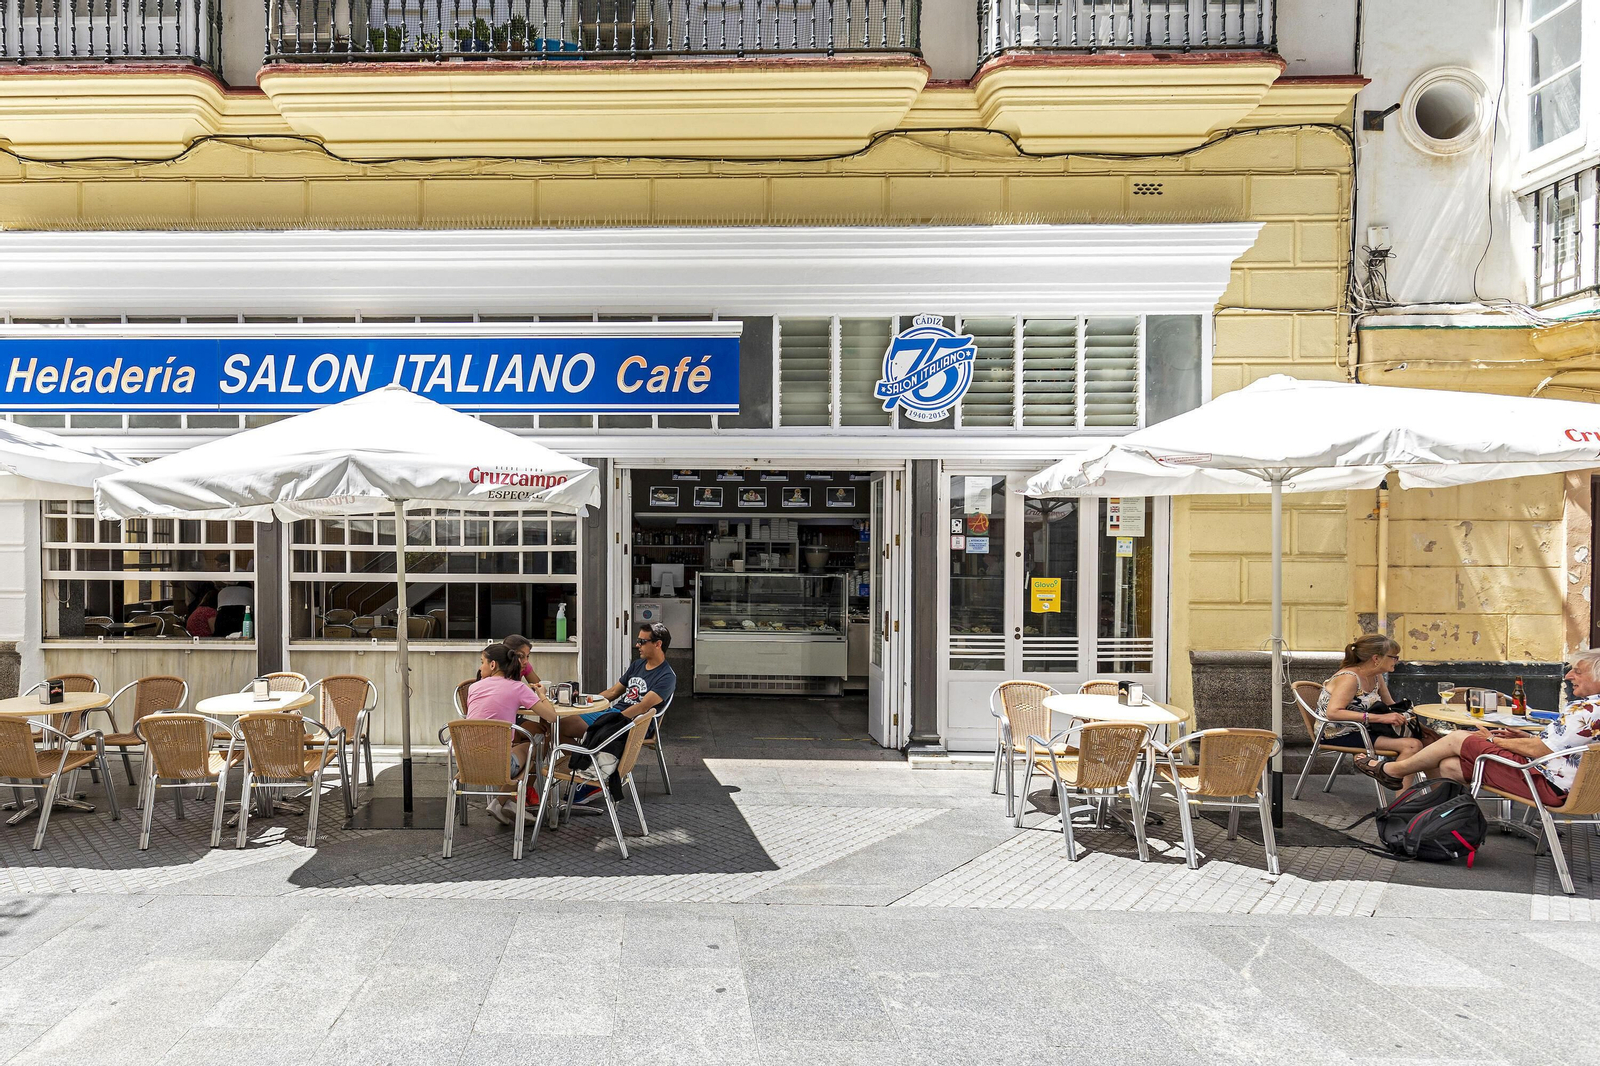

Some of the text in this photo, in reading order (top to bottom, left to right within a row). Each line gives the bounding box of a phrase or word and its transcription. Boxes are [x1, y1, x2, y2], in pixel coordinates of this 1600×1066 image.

[915, 315, 942, 326] CÁDIZ
[5, 352, 712, 394] Heladería SALON ITALIANO Café
[886, 350, 966, 394] SALON ITALIANO
[908, 410, 947, 420] 1940-2015
[468, 466, 567, 489] Cruzcampo
